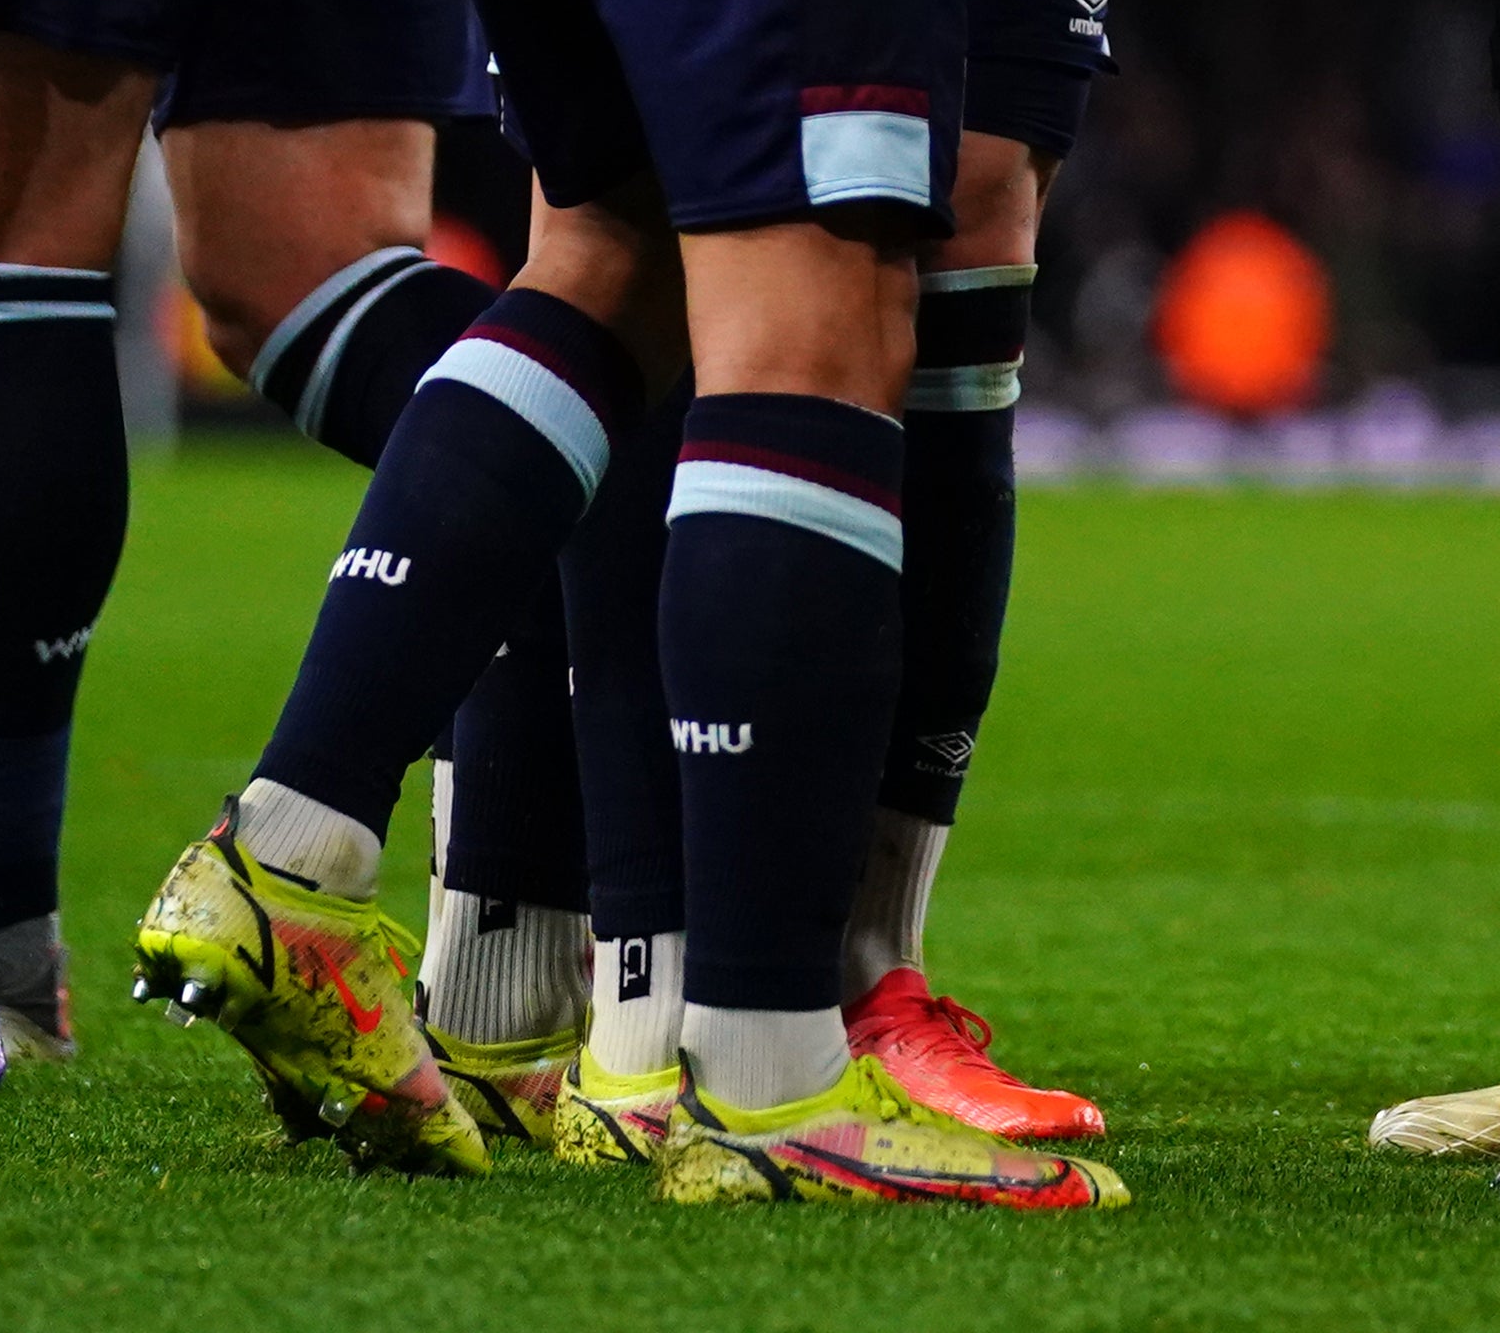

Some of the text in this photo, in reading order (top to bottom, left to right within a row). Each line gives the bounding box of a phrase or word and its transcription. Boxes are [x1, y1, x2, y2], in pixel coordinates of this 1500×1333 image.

[1069, 16, 1104, 36] umbr
[328, 547, 412, 586] WHU
[670, 717, 754, 754] WHU
